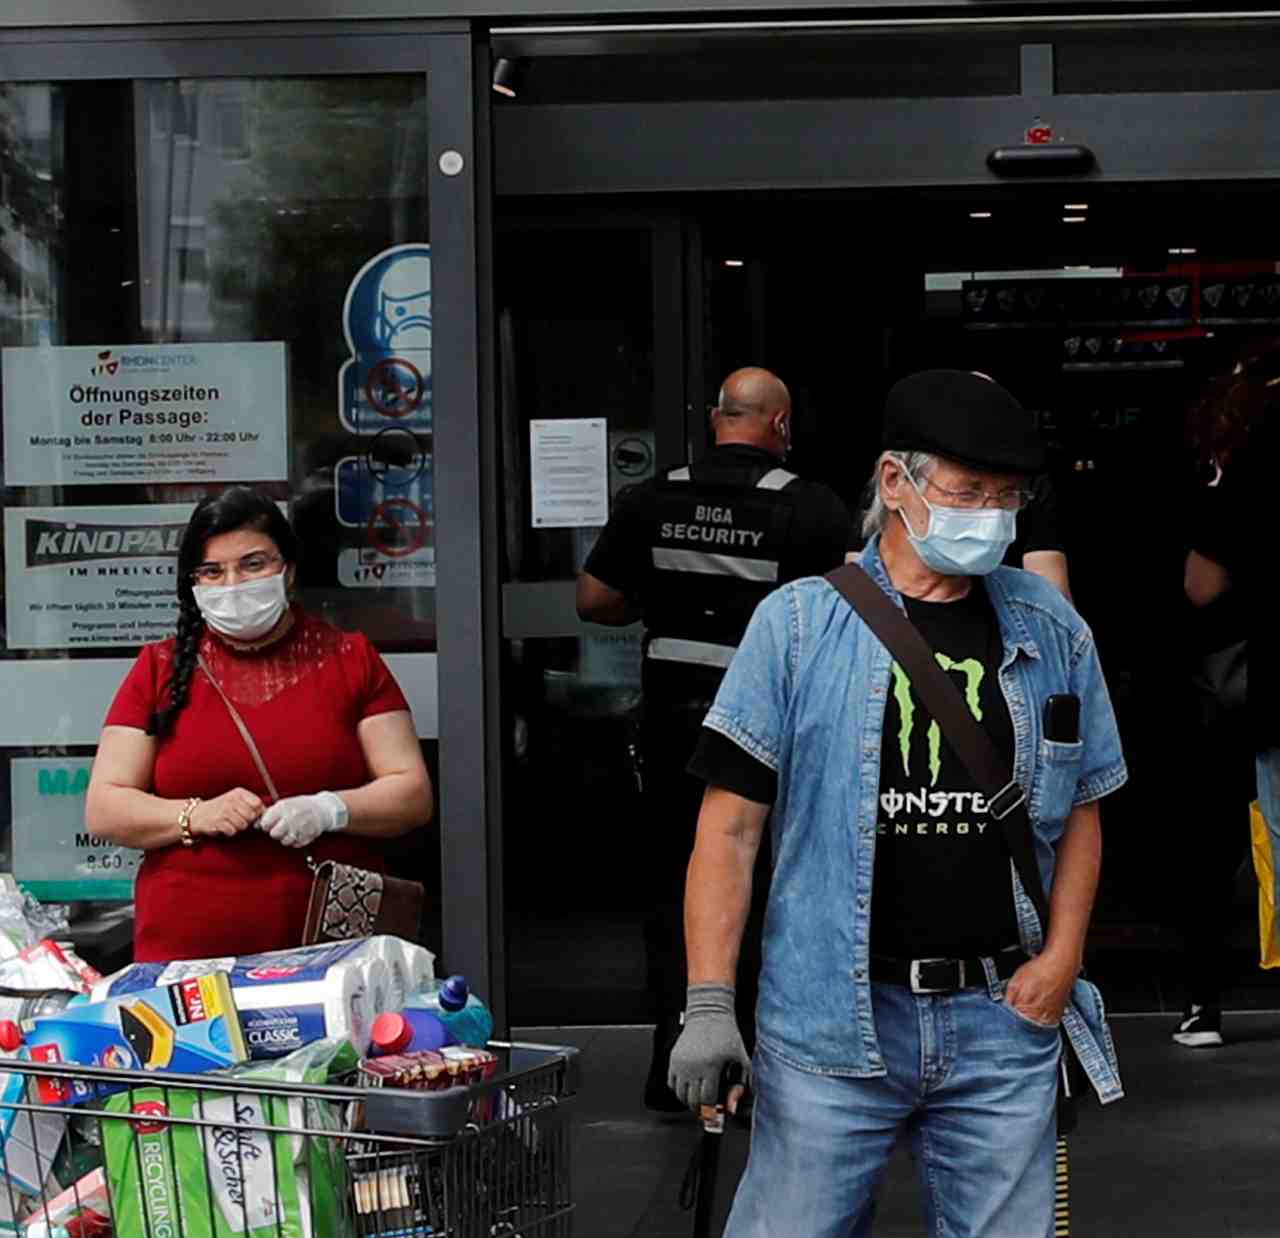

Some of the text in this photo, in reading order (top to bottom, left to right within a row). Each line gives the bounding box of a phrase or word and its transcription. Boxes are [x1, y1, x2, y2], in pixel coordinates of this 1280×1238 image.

[69, 384, 220, 406] Öffnungszeiten
[81, 408, 209, 428] der Passage:
[29, 435, 71, 447] Montag
[73, 435, 91, 445] bis
[94, 434, 143, 446] Samstag
[176, 432, 196, 443] Uhr
[238, 431, 260, 442] Uhr
[695, 505, 733, 524] BIGA
[660, 523, 764, 548] SECURITY
[69, 566, 177, 577] IM RHEINCE
[879, 787, 989, 819] ONSTE
[248, 1027, 301, 1044] CLASSIC
